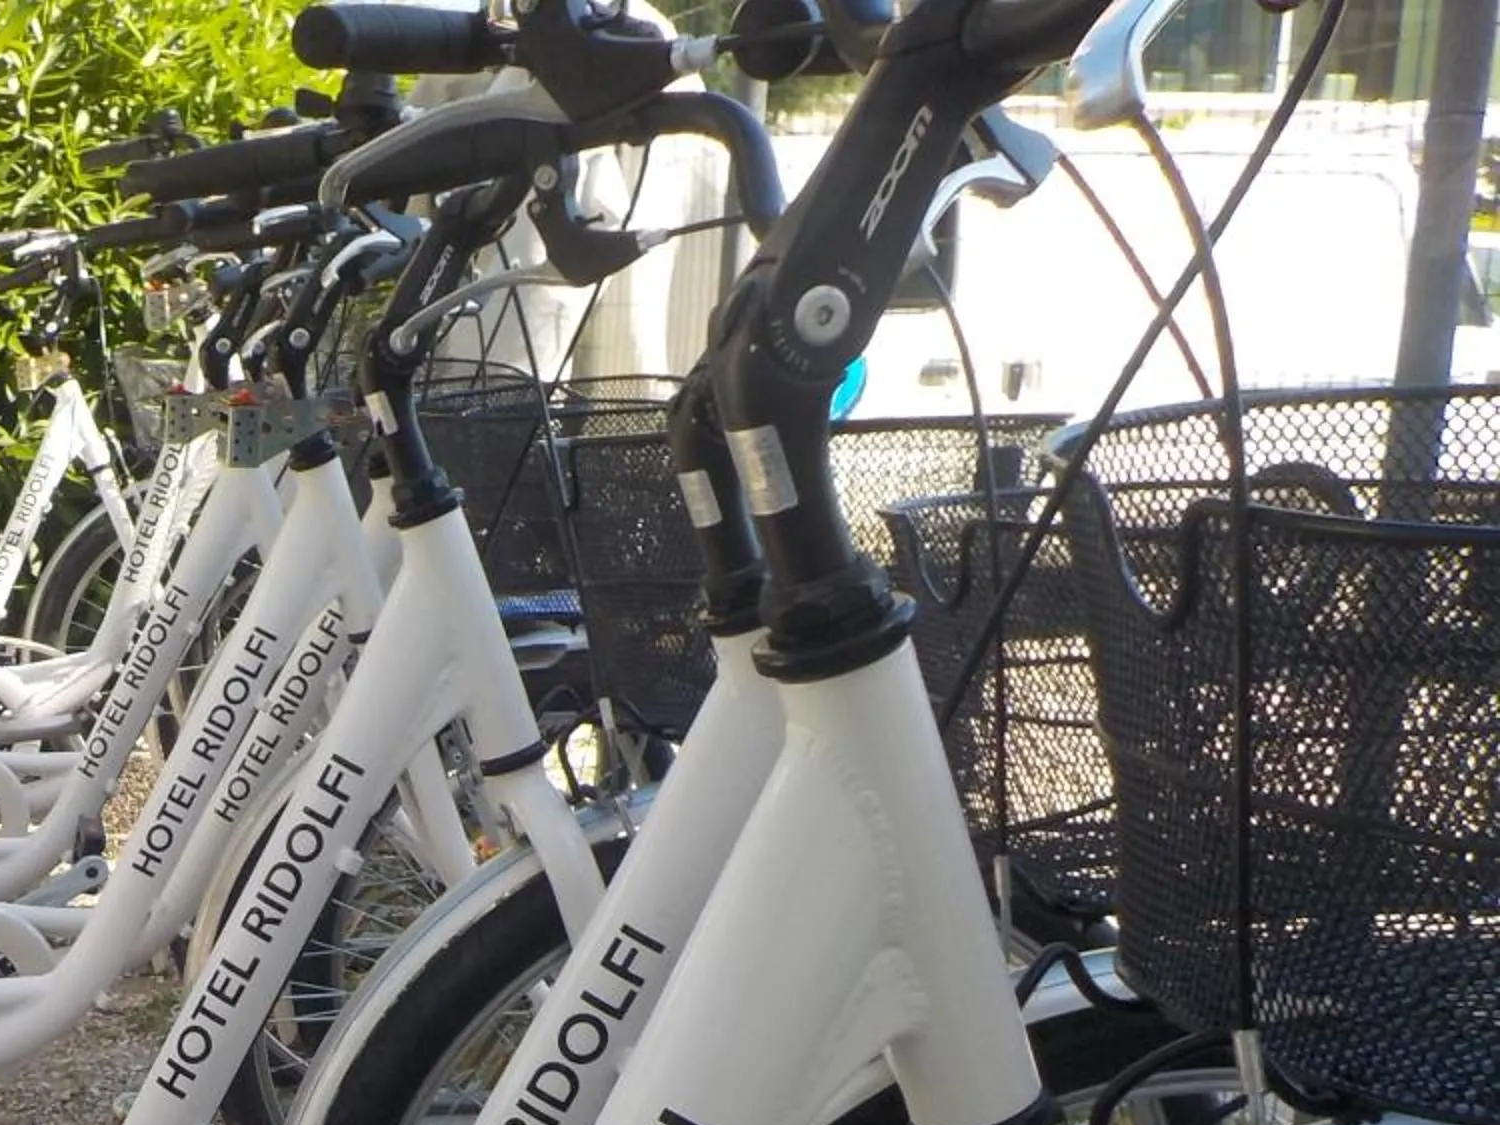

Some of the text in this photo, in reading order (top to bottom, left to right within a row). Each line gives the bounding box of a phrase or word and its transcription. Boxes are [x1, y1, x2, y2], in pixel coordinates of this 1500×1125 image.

[16, 452, 55, 524] RIDOLFI
[124, 443, 185, 583] HOTEL RIDOL
[78, 585, 190, 779] HOTEL RIDOLFI
[132, 626, 278, 878] HOTEL RIDOLFI
[215, 608, 344, 823] HOTEL RIDOLFI
[156, 753, 365, 1100] HOTEL RIDOLFI
